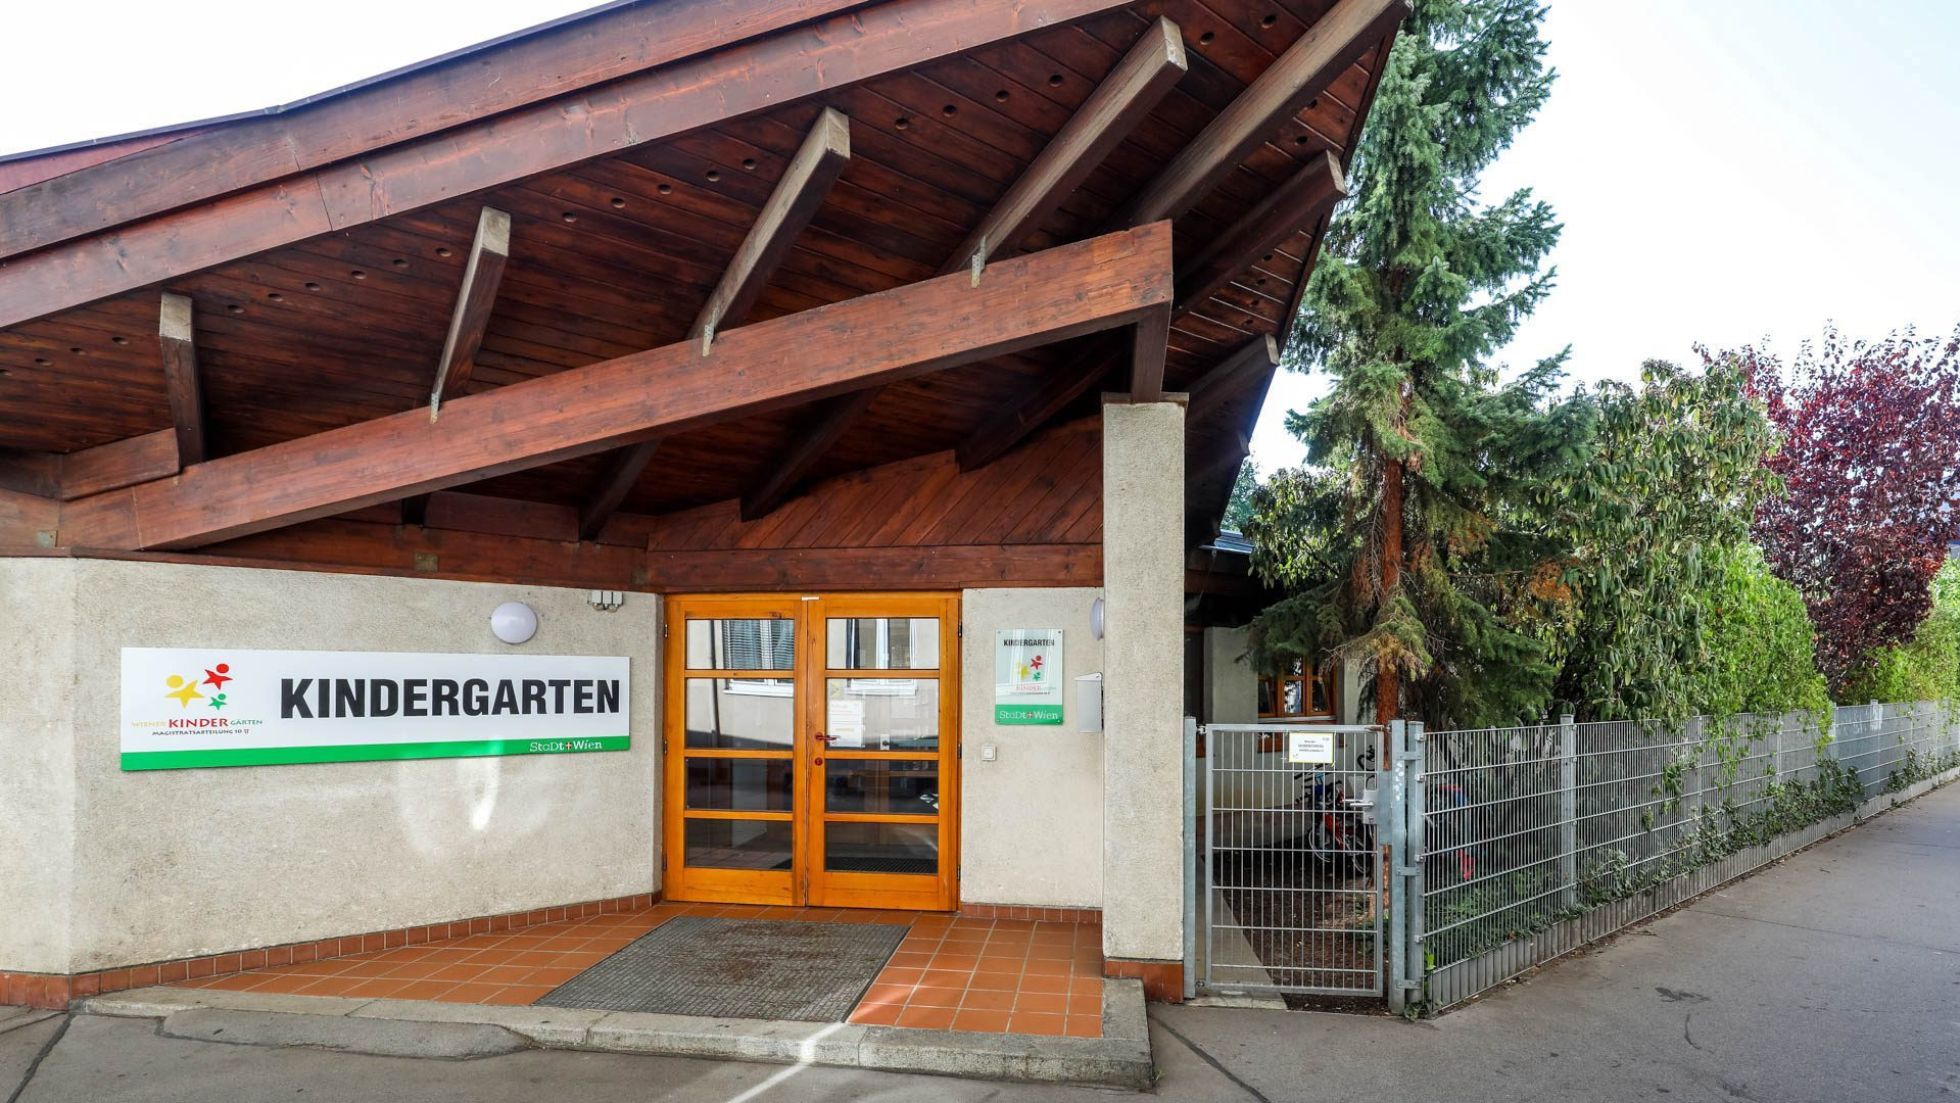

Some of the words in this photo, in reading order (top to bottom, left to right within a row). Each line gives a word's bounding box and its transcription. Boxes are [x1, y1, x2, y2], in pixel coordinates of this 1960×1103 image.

[281, 678, 620, 719] KINDERGARTEN
[1034, 710, 1058, 719] Wien
[168, 718, 229, 728] KINDER
[573, 739, 603, 750] Wien
